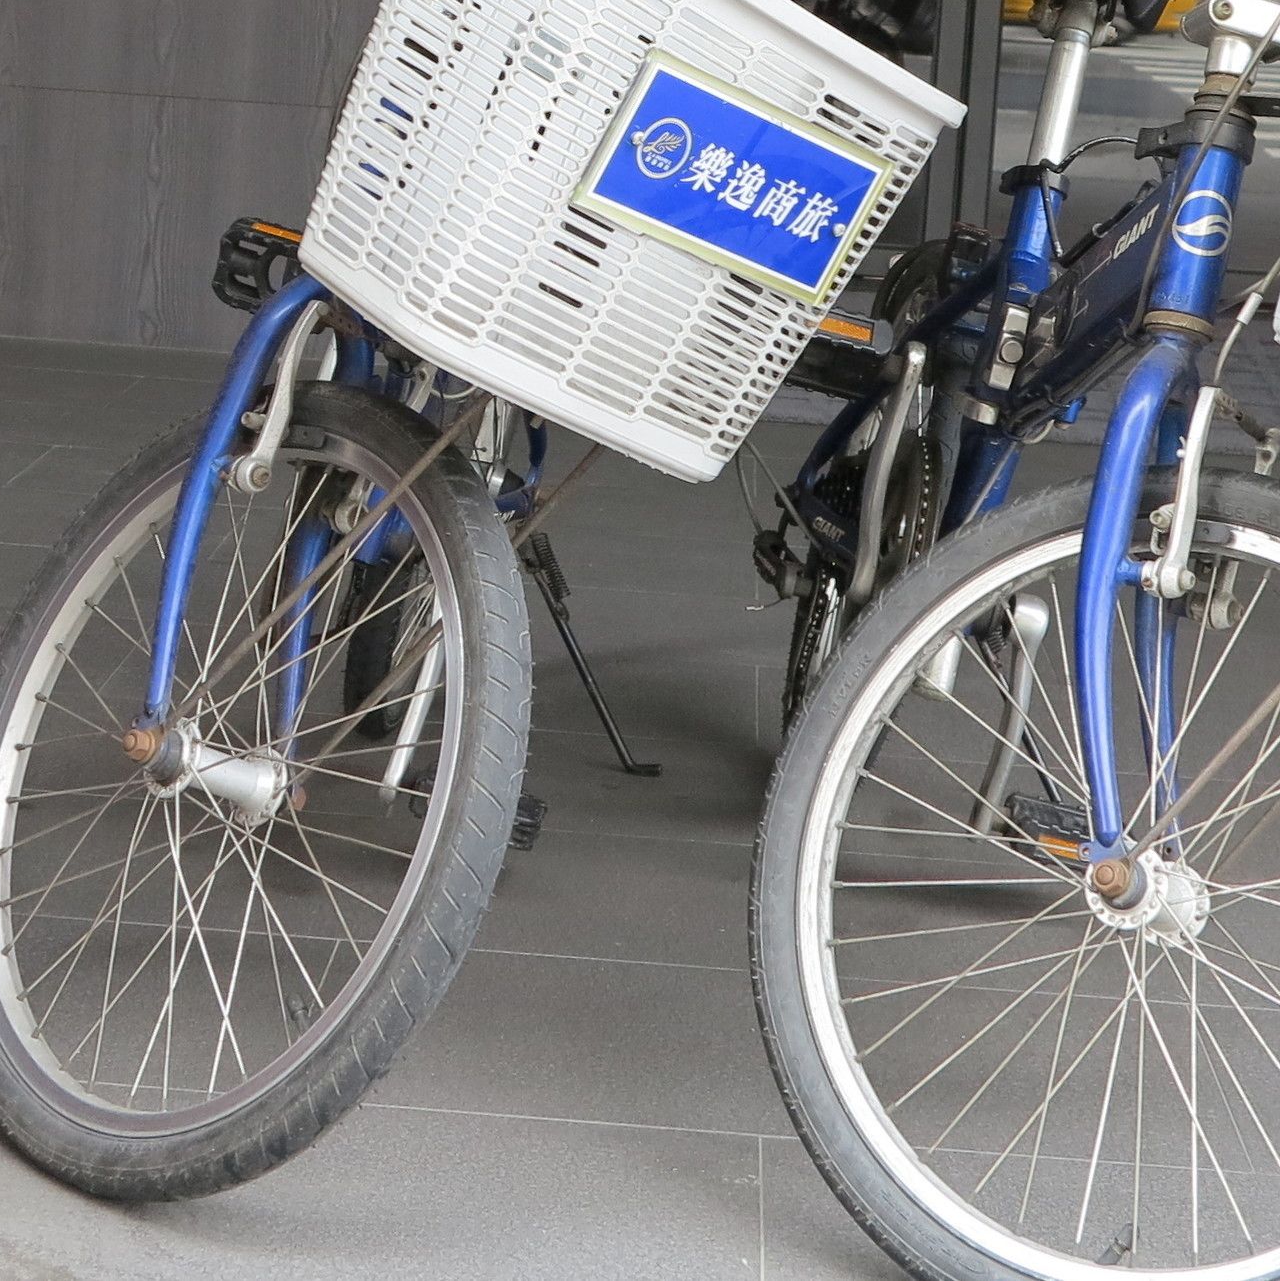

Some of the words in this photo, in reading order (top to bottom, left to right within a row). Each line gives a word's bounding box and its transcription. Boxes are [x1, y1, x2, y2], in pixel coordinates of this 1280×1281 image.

[680, 142, 839, 243] 樂逸商旅
[1113, 203, 1160, 259] GIANT
[813, 516, 845, 542] GIANT
